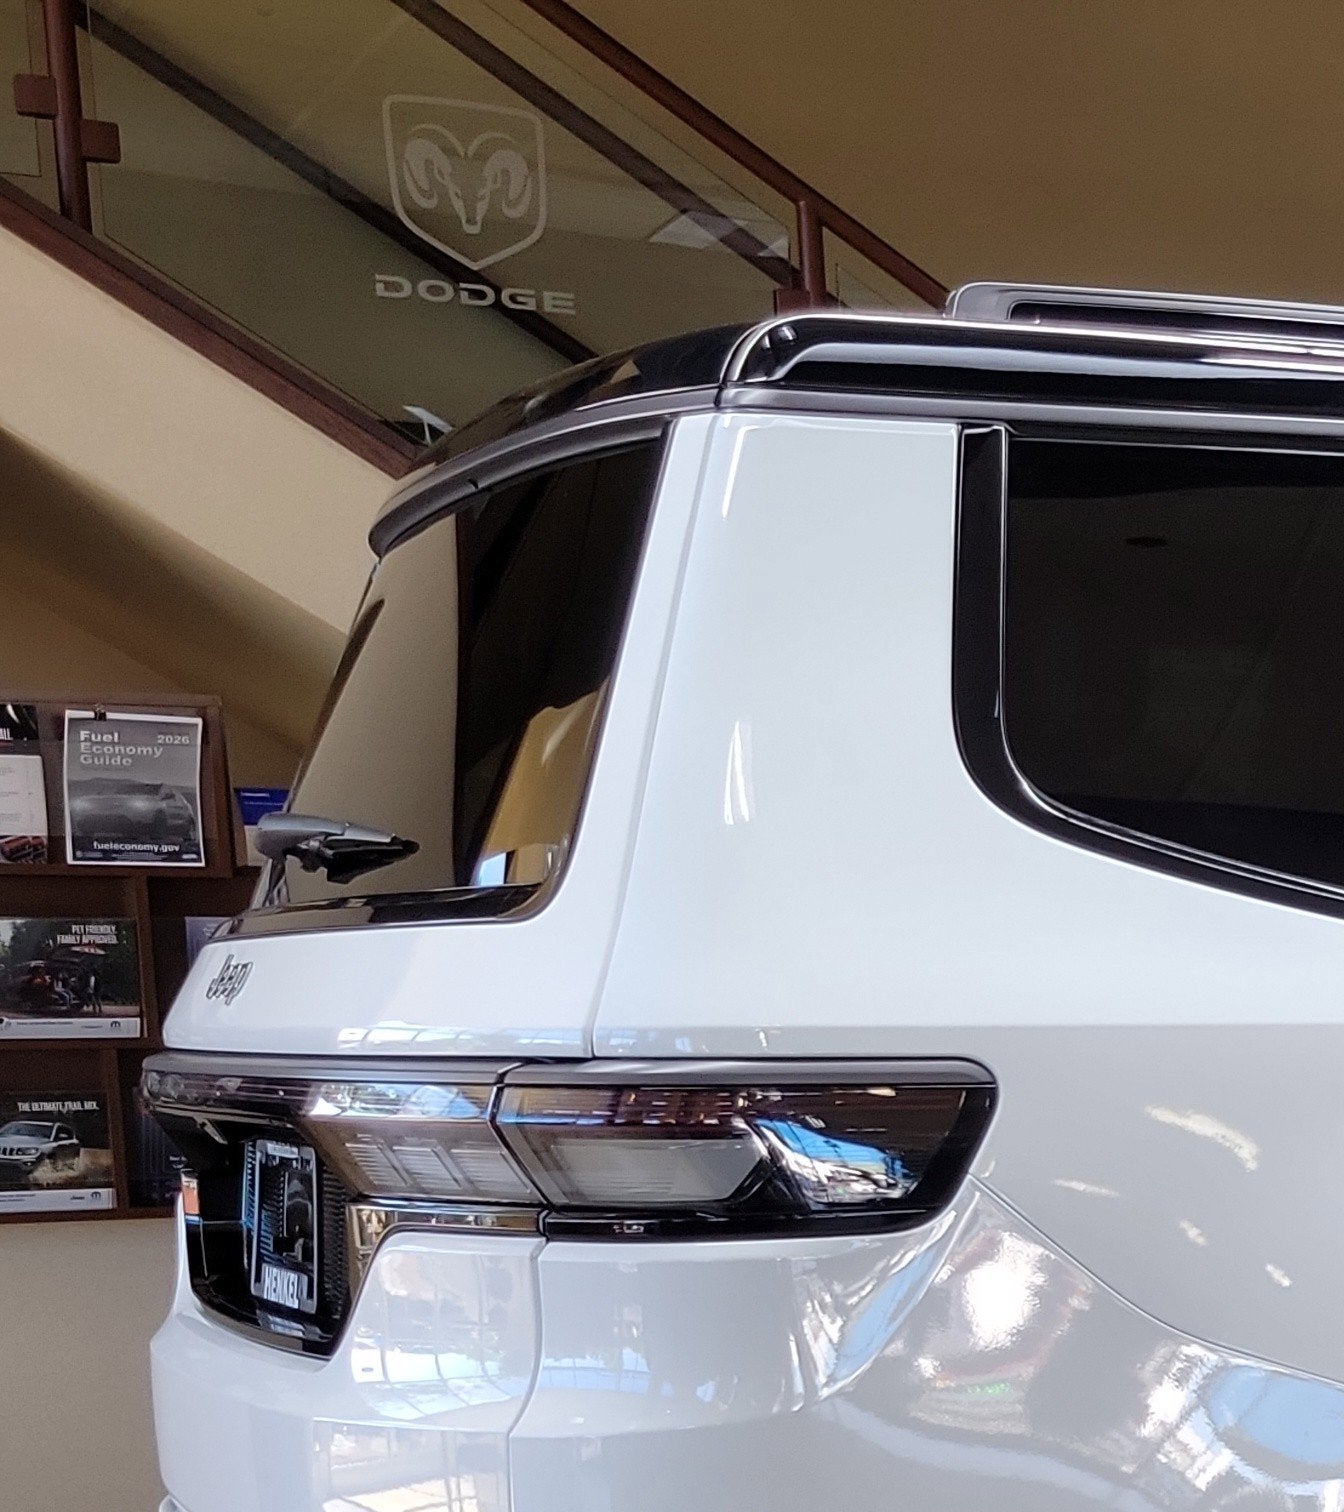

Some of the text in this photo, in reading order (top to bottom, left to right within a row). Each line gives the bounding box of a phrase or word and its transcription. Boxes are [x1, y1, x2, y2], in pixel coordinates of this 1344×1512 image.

[375, 273, 576, 315] DODGE
[79, 730, 191, 745] Fuel 2026
[80, 742, 164, 758] Economy
[80, 754, 133, 766] Guide
[93, 841, 181, 853] fueleconomy.gov
[206, 954, 254, 1006] Jeep
[263, 1265, 300, 1310] HENKEL
